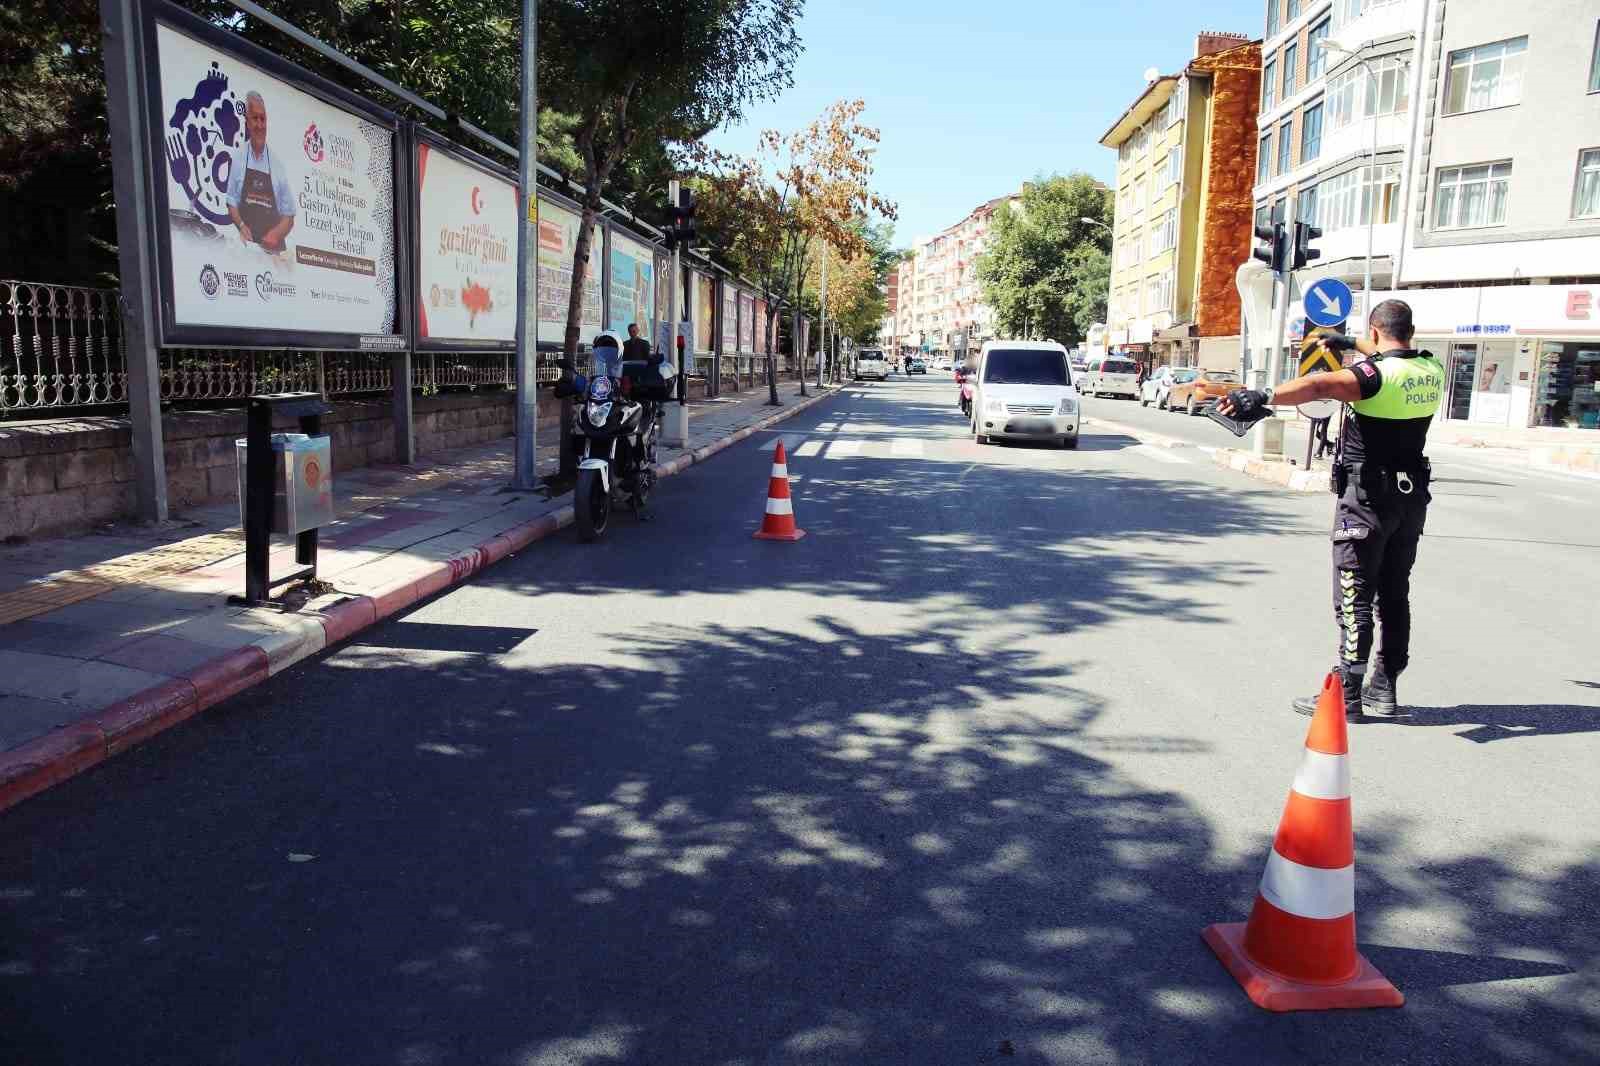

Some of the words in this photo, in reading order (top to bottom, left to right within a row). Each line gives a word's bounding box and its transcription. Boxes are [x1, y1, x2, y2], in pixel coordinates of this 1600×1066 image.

[304, 175, 313, 194] 5.
[299, 192, 330, 216] Gastro
[305, 210, 335, 233] Lezzet
